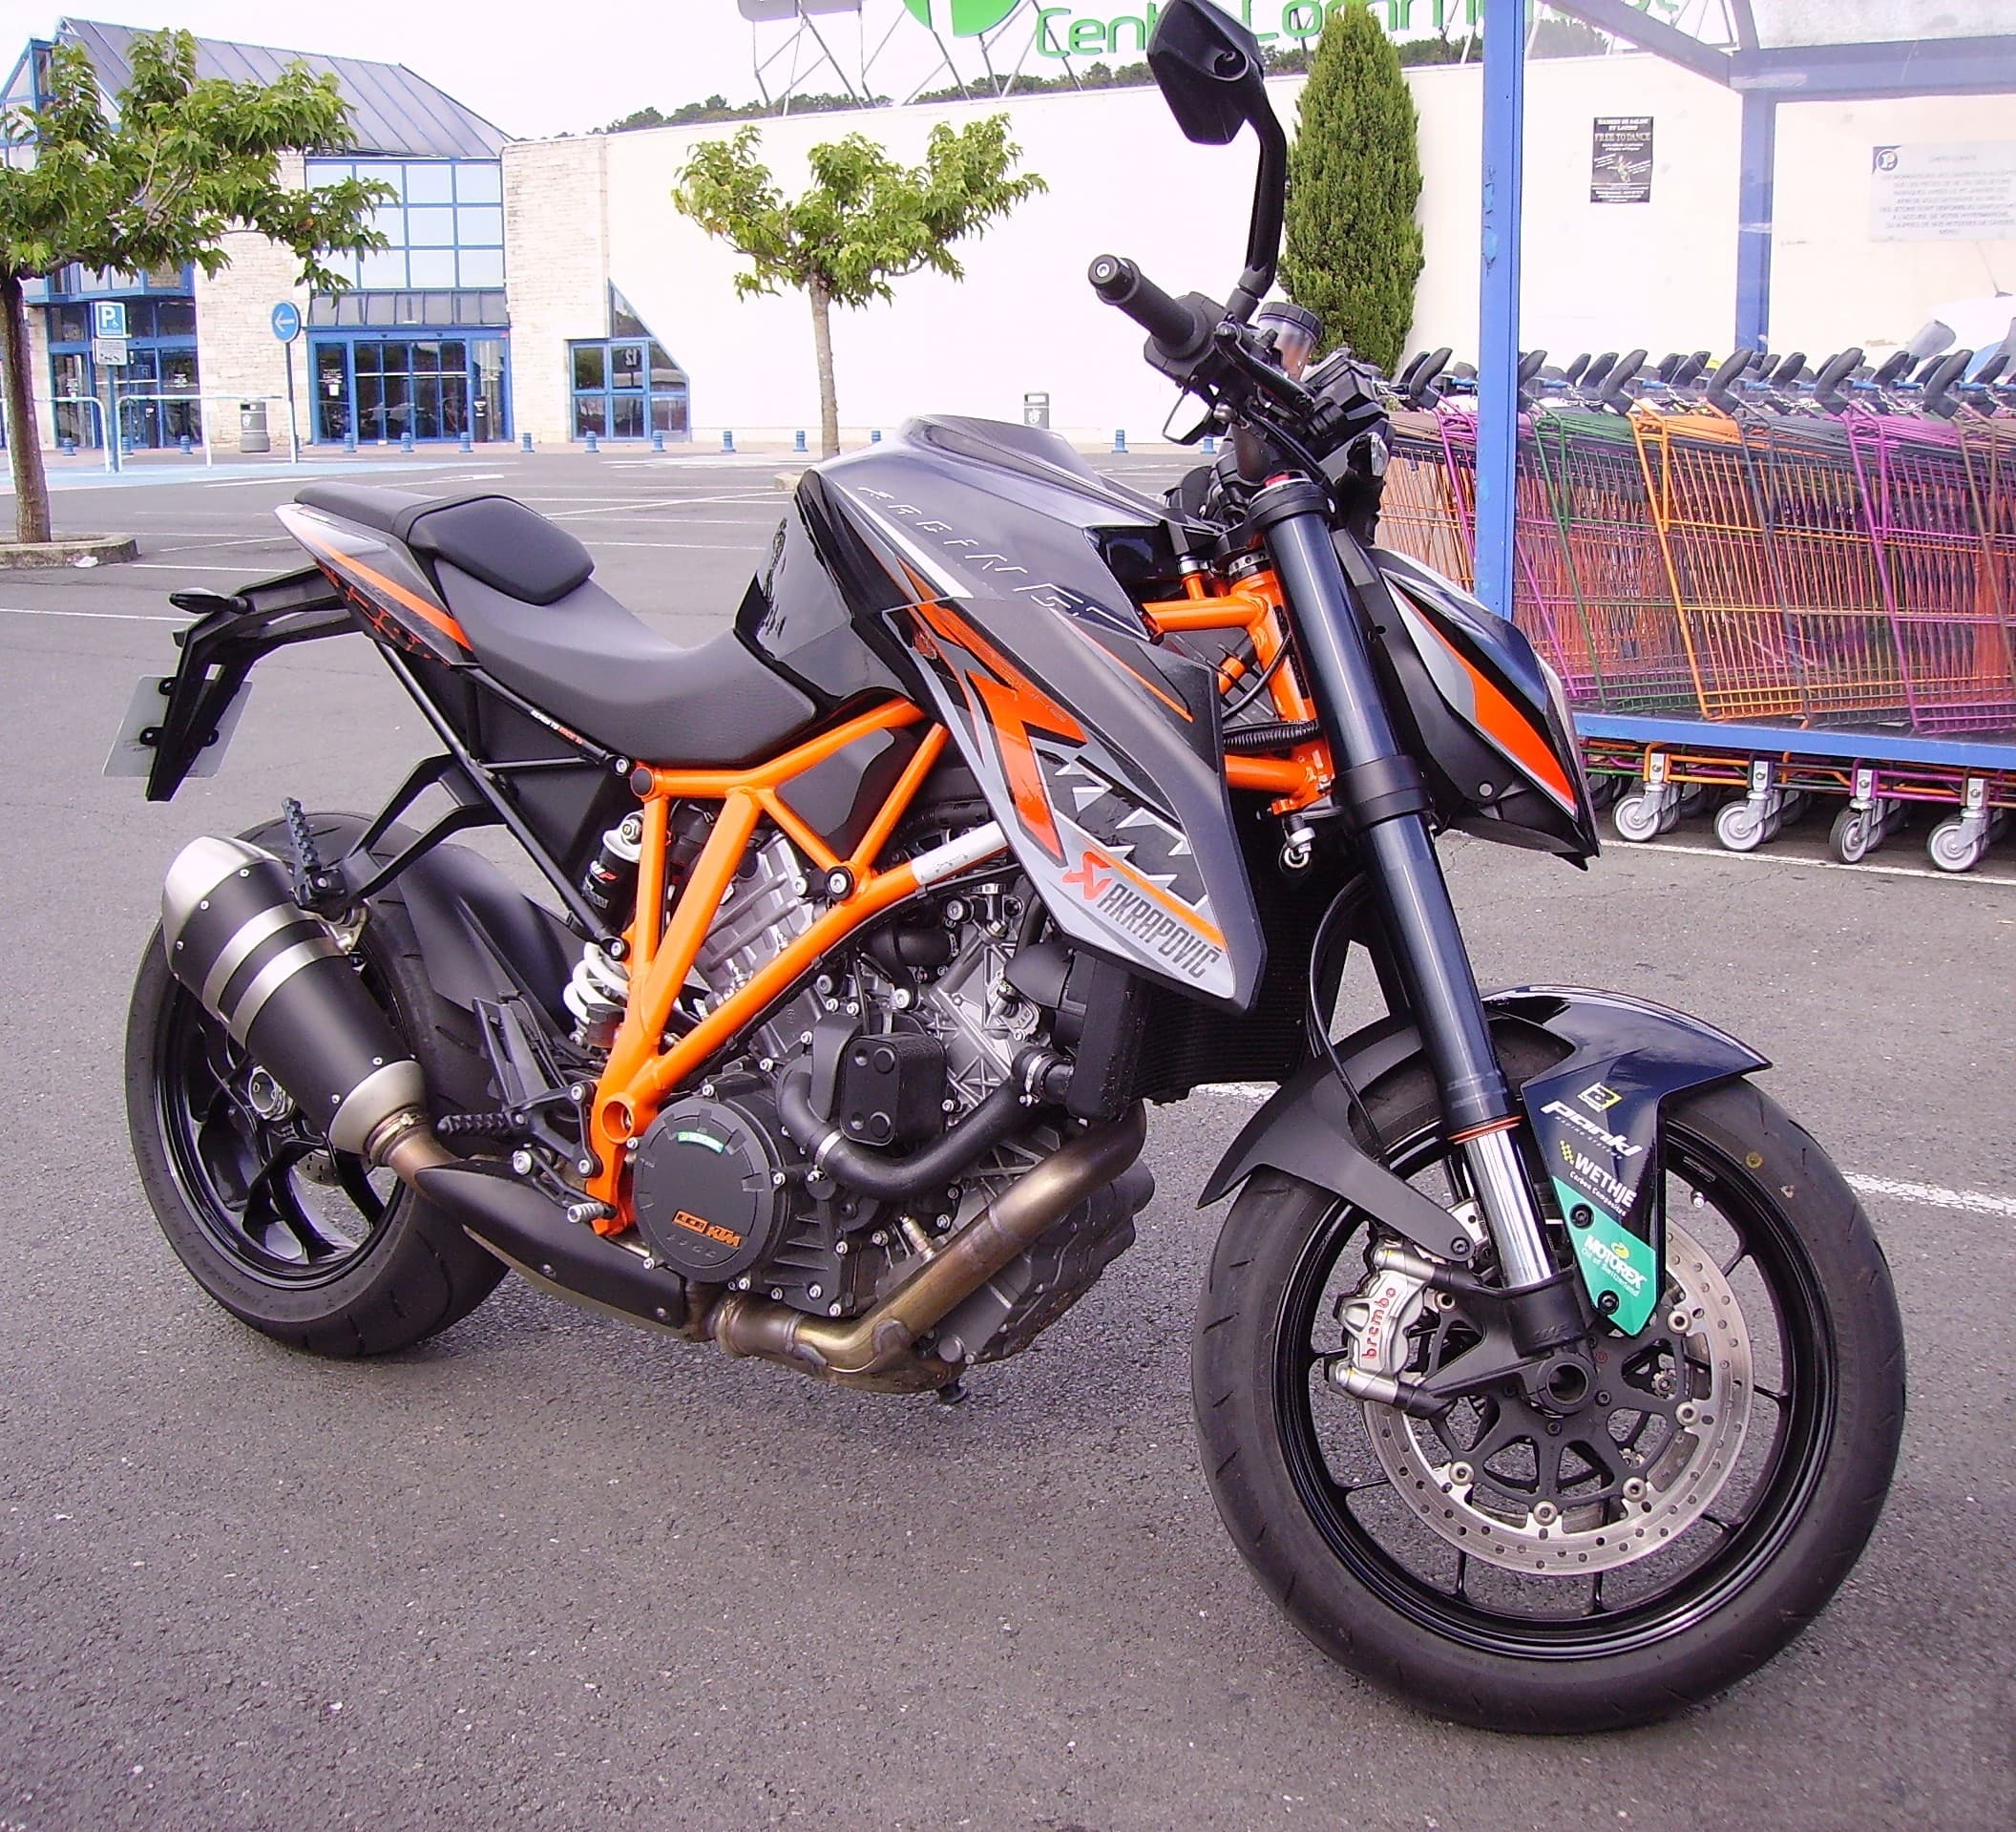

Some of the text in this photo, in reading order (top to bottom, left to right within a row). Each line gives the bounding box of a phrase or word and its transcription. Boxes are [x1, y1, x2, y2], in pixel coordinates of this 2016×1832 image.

[102, 306, 116, 327] P
[1097, 883, 1222, 979] AKRAPOVIČ
[1575, 1152, 1638, 1209] WETHJE
[706, 1225, 741, 1247] KTM
[1584, 1233, 1648, 1290] MOTOREX
[1361, 1287, 1396, 1359] brembo
